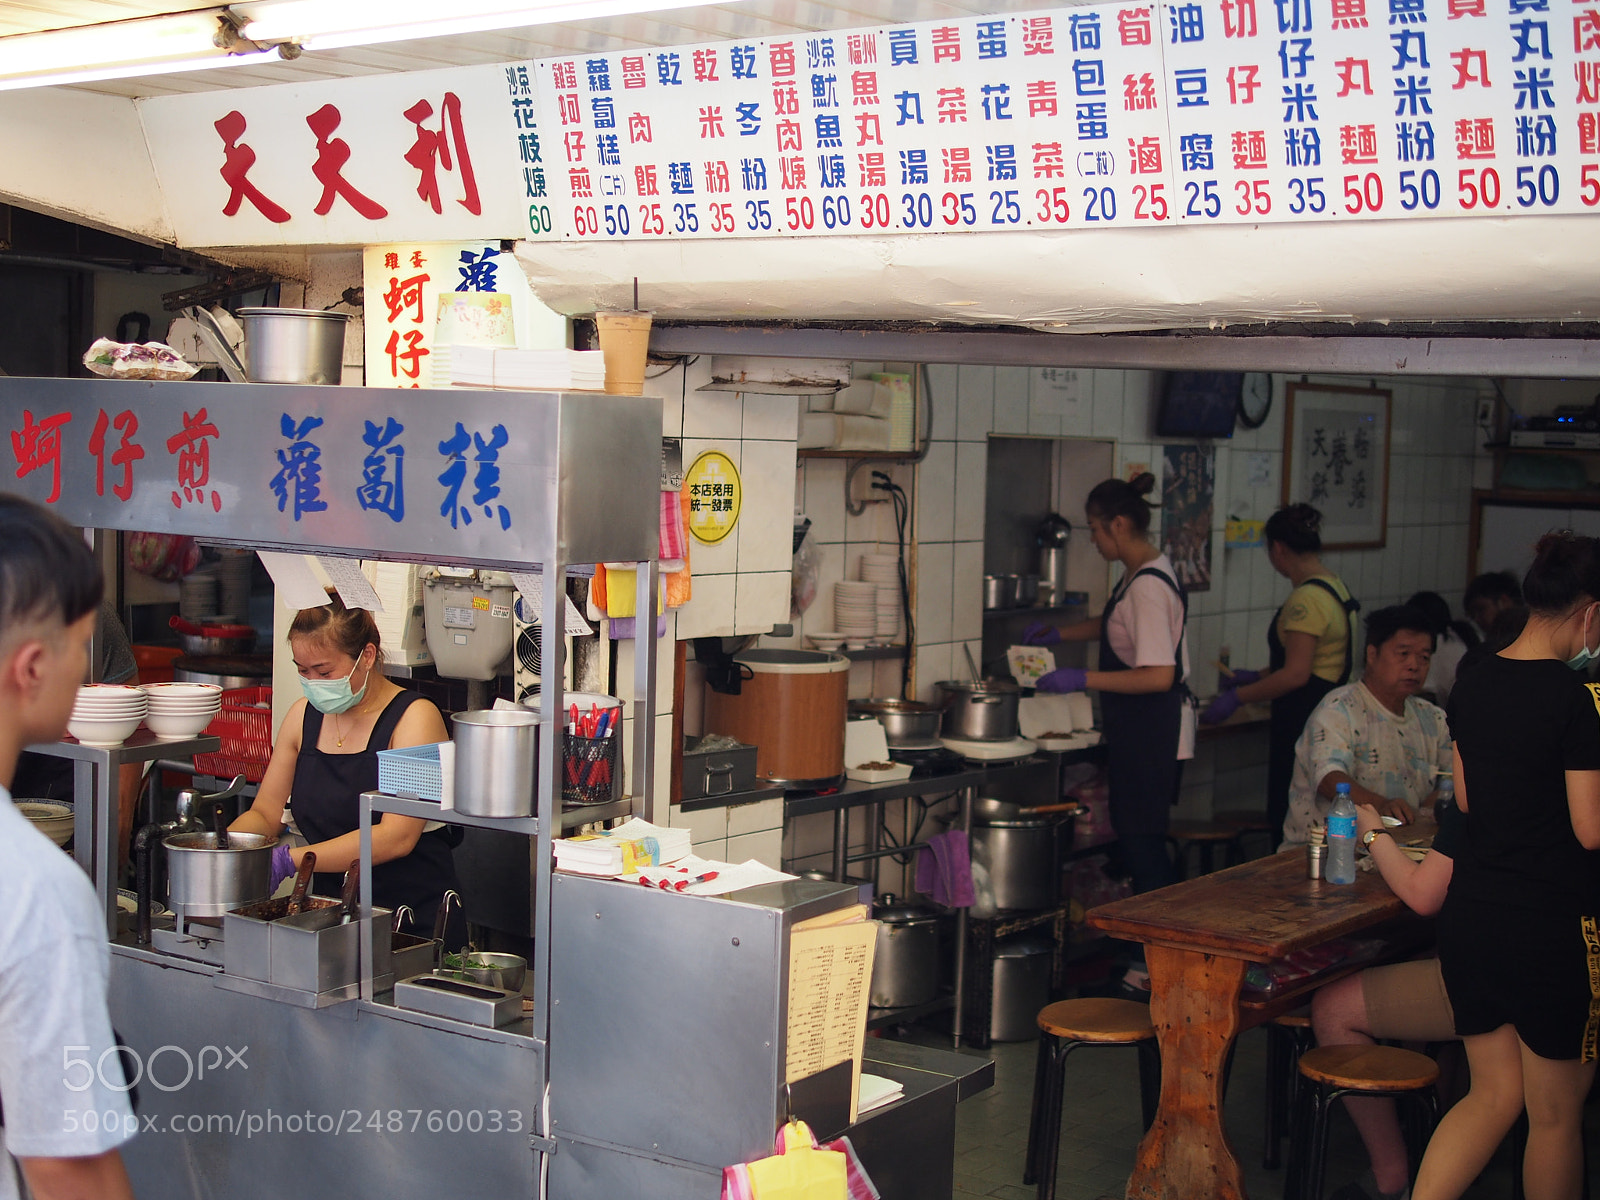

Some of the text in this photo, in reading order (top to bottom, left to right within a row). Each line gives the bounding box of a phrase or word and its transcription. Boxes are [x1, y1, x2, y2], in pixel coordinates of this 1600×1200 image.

[215, 92, 481, 223] 天天利
[1132, 184, 1167, 220] 25
[1186, 181, 1221, 217] 25
[1235, 180, 1271, 215] 35
[1289, 178, 1325, 213] 35
[1344, 172, 1383, 214] 50
[1401, 169, 1440, 209] 50
[1459, 167, 1500, 209] 50
[1518, 165, 1559, 206] 50
[529, 205, 551, 234] 60
[605, 205, 629, 235] 50
[640, 204, 664, 235] 25
[674, 204, 698, 232] 35
[709, 203, 735, 232] 35
[746, 201, 771, 230] 35
[786, 197, 814, 230] 50
[823, 196, 851, 228] 60
[861, 194, 890, 228] 30
[903, 193, 932, 227] 30
[942, 192, 976, 225] 35
[990, 191, 1020, 223] 25
[1036, 187, 1069, 223] 35
[1084, 187, 1116, 220] 20
[575, 206, 598, 236] 60
[383, 273, 430, 388] 蚵仔
[11, 408, 511, 530] 蚵仔煎 蘿蔔糕
[690, 483, 734, 498] 本店免用
[690, 499, 733, 512] 統一發票
